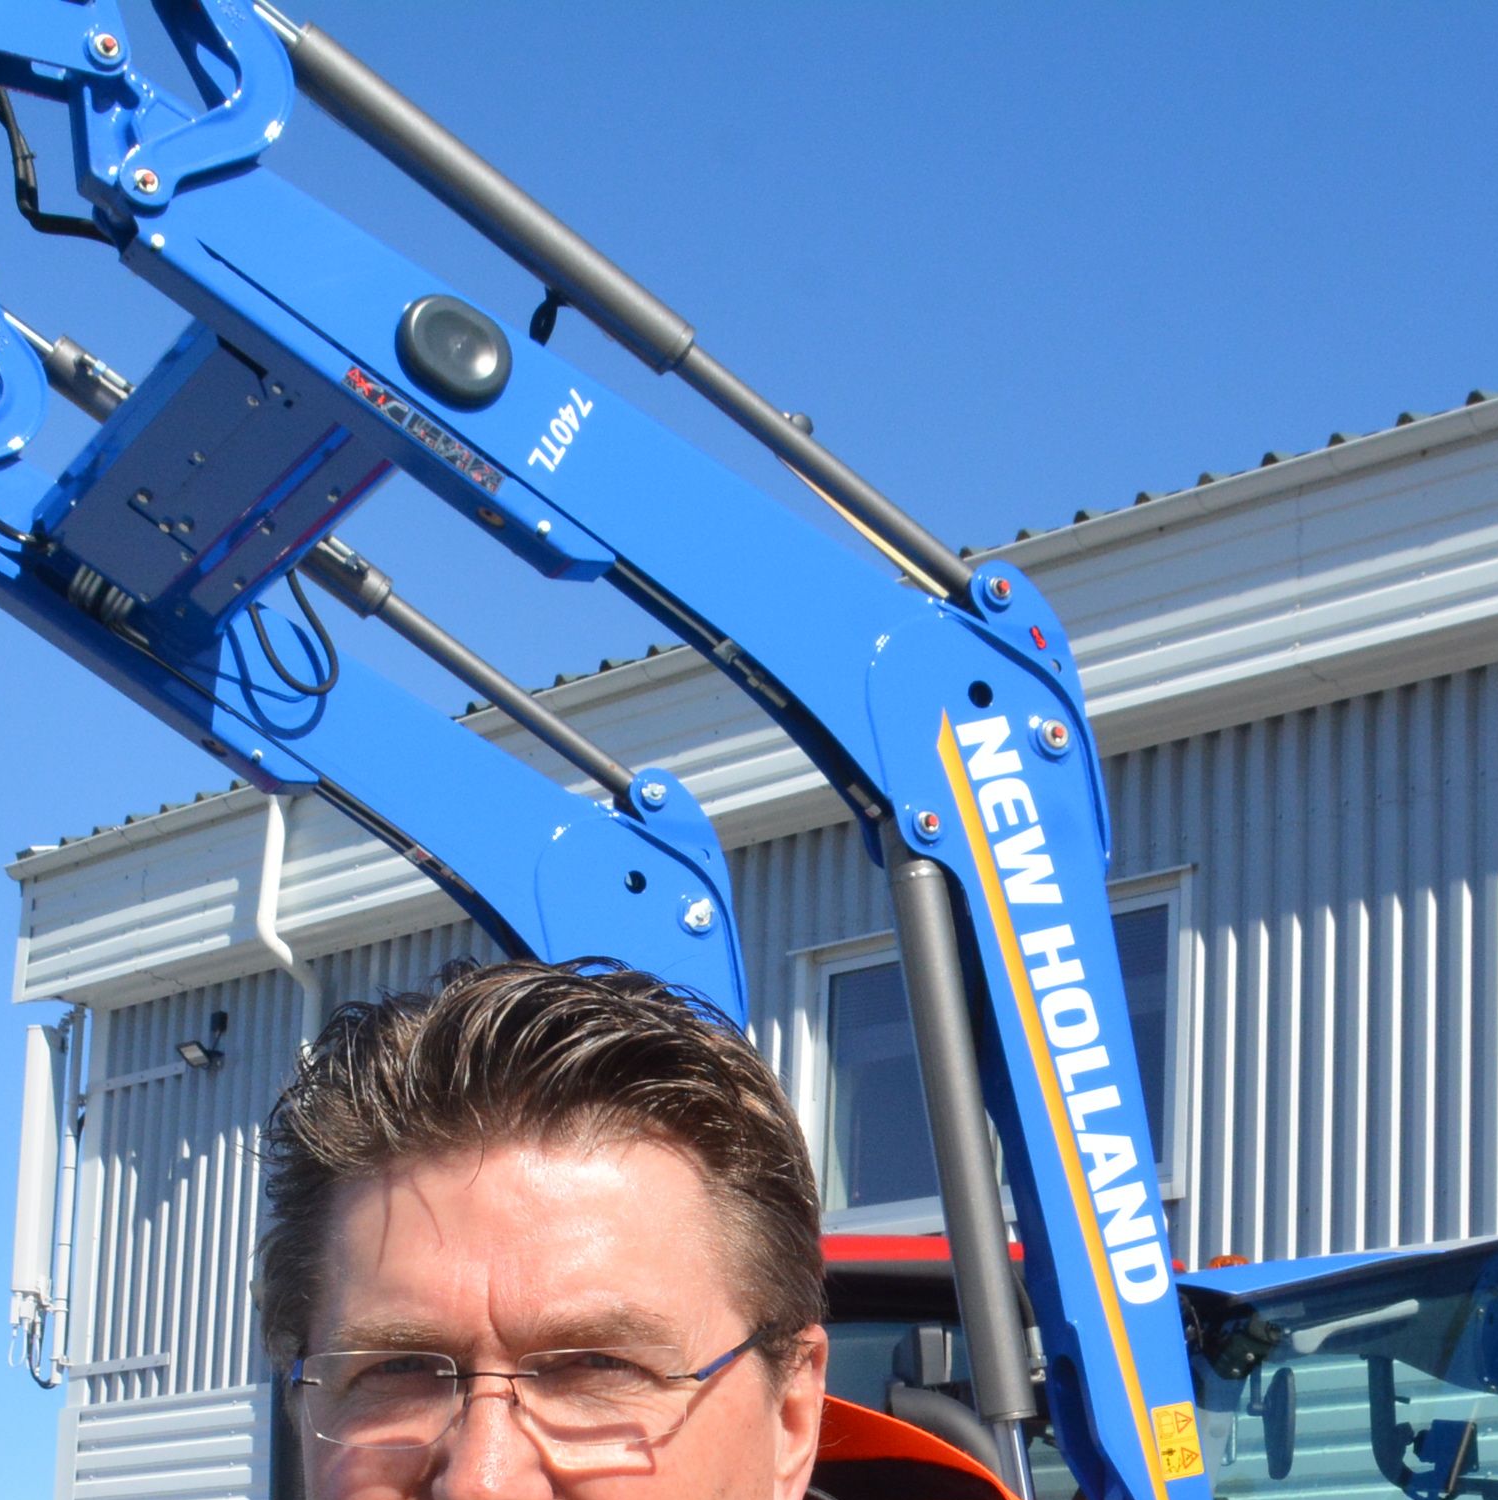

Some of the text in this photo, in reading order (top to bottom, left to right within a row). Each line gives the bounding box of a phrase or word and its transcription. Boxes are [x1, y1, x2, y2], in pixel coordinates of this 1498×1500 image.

[527, 388, 594, 473] 740TL
[955, 715, 1171, 1305] NEW HOLLAND
